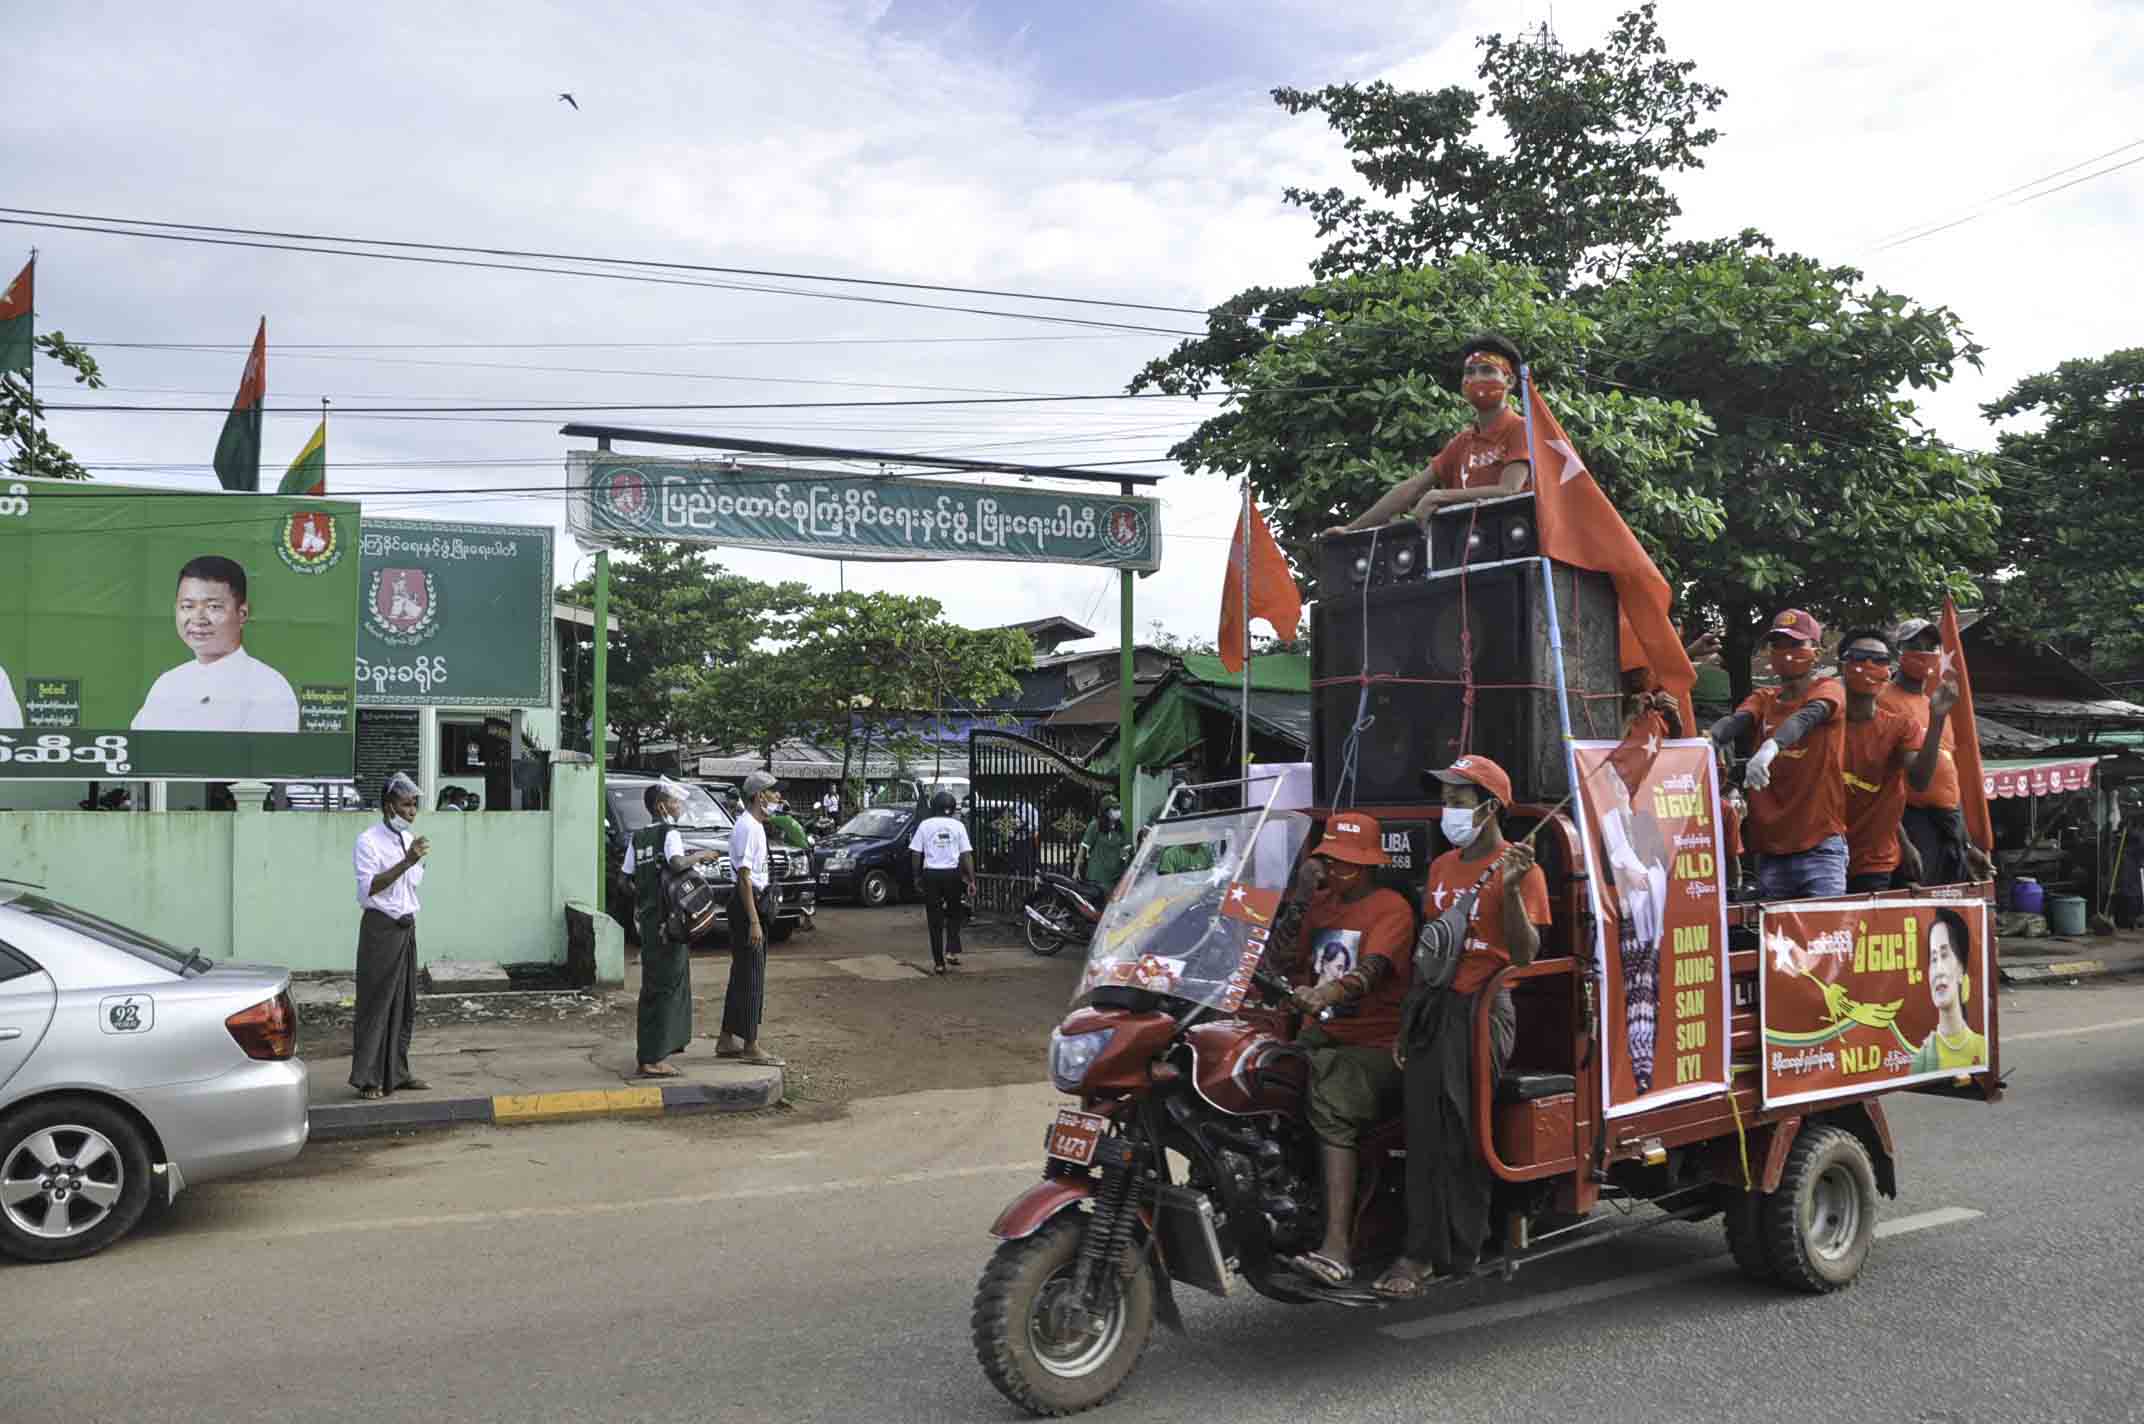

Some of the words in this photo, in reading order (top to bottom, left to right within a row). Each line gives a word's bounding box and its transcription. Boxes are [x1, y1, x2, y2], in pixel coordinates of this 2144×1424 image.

[1674, 852, 1714, 881] NLD
[1673, 925, 1709, 954] DAW
[1674, 955, 1715, 987] AUNG
[116, 1006, 135, 1021] 92
[1675, 989, 1704, 1019] SAN
[1676, 1020, 1707, 1051] SUU
[1677, 1053, 1702, 1084] KYI
[1840, 1044, 1880, 1075] NLD
